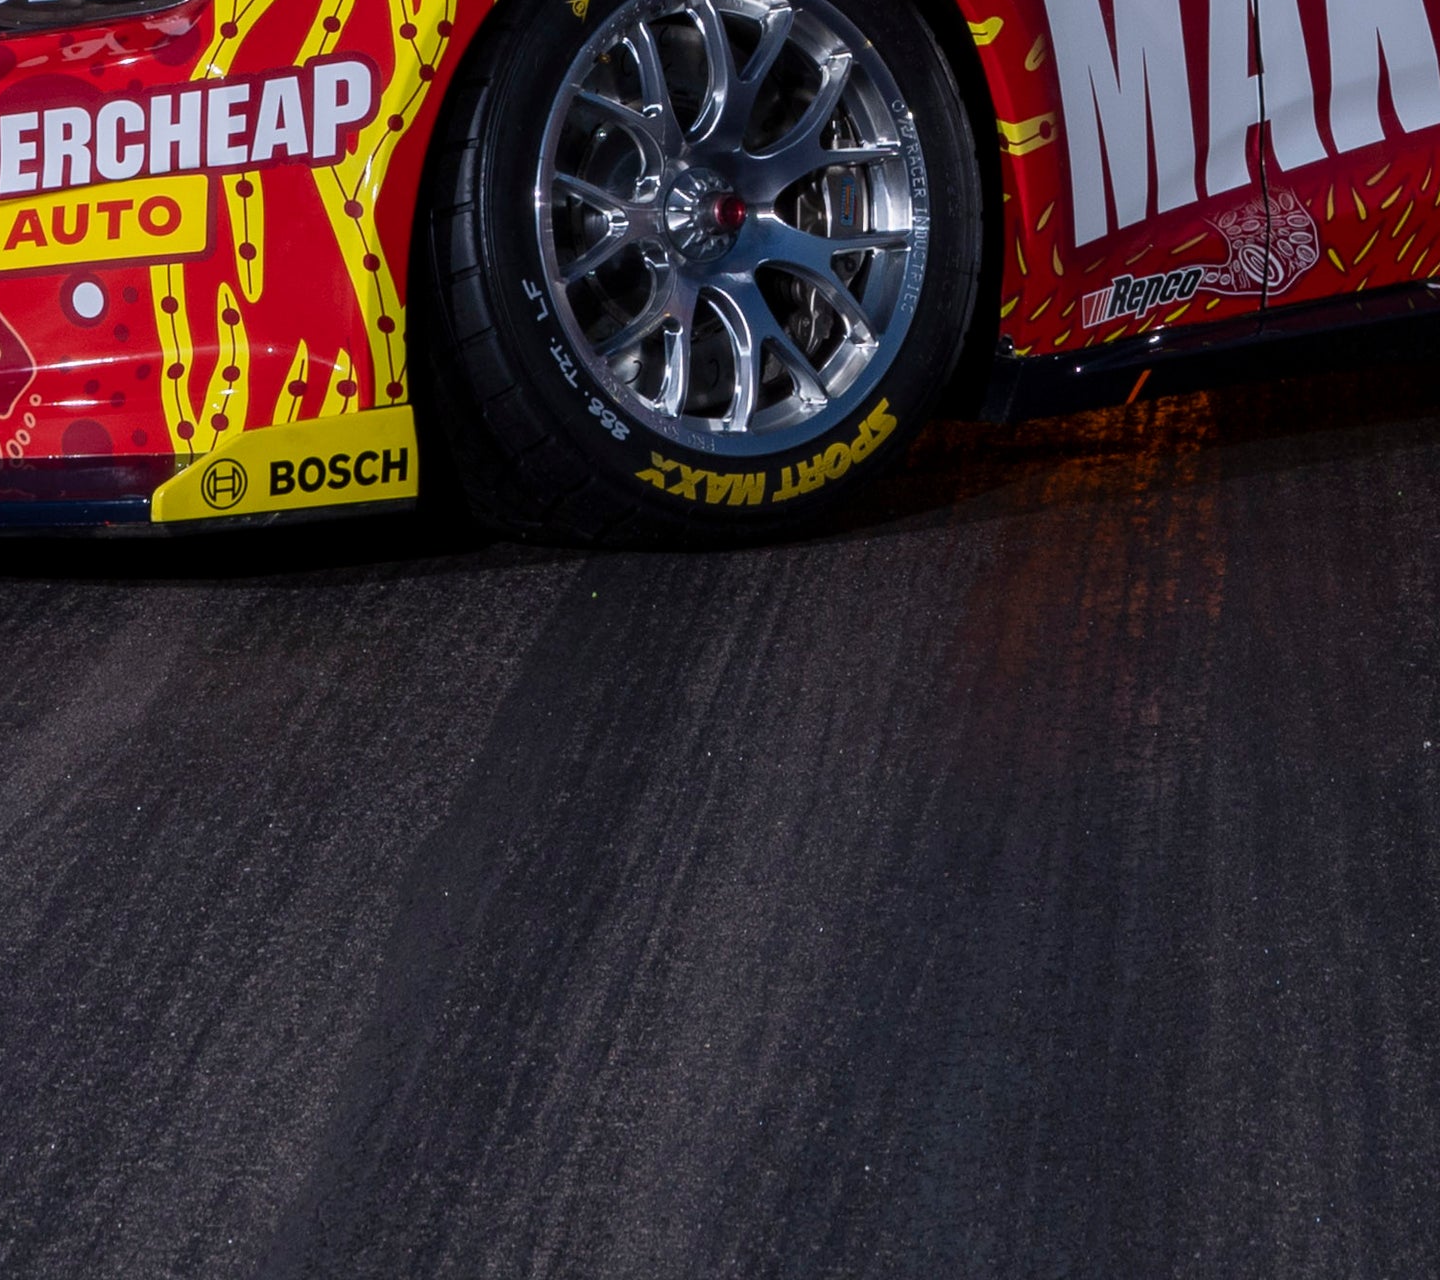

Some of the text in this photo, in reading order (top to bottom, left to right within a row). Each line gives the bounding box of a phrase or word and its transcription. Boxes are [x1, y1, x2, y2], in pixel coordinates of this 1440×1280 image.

[1, 194, 183, 252] AUTO
[521, 278, 550, 322] LF
[1106, 266, 1205, 320] Repco
[586, 396, 631, 441] 888
[268, 447, 409, 497] BOSCH
[771, 396, 898, 503] SPORT
[633, 450, 766, 507] MAXX
